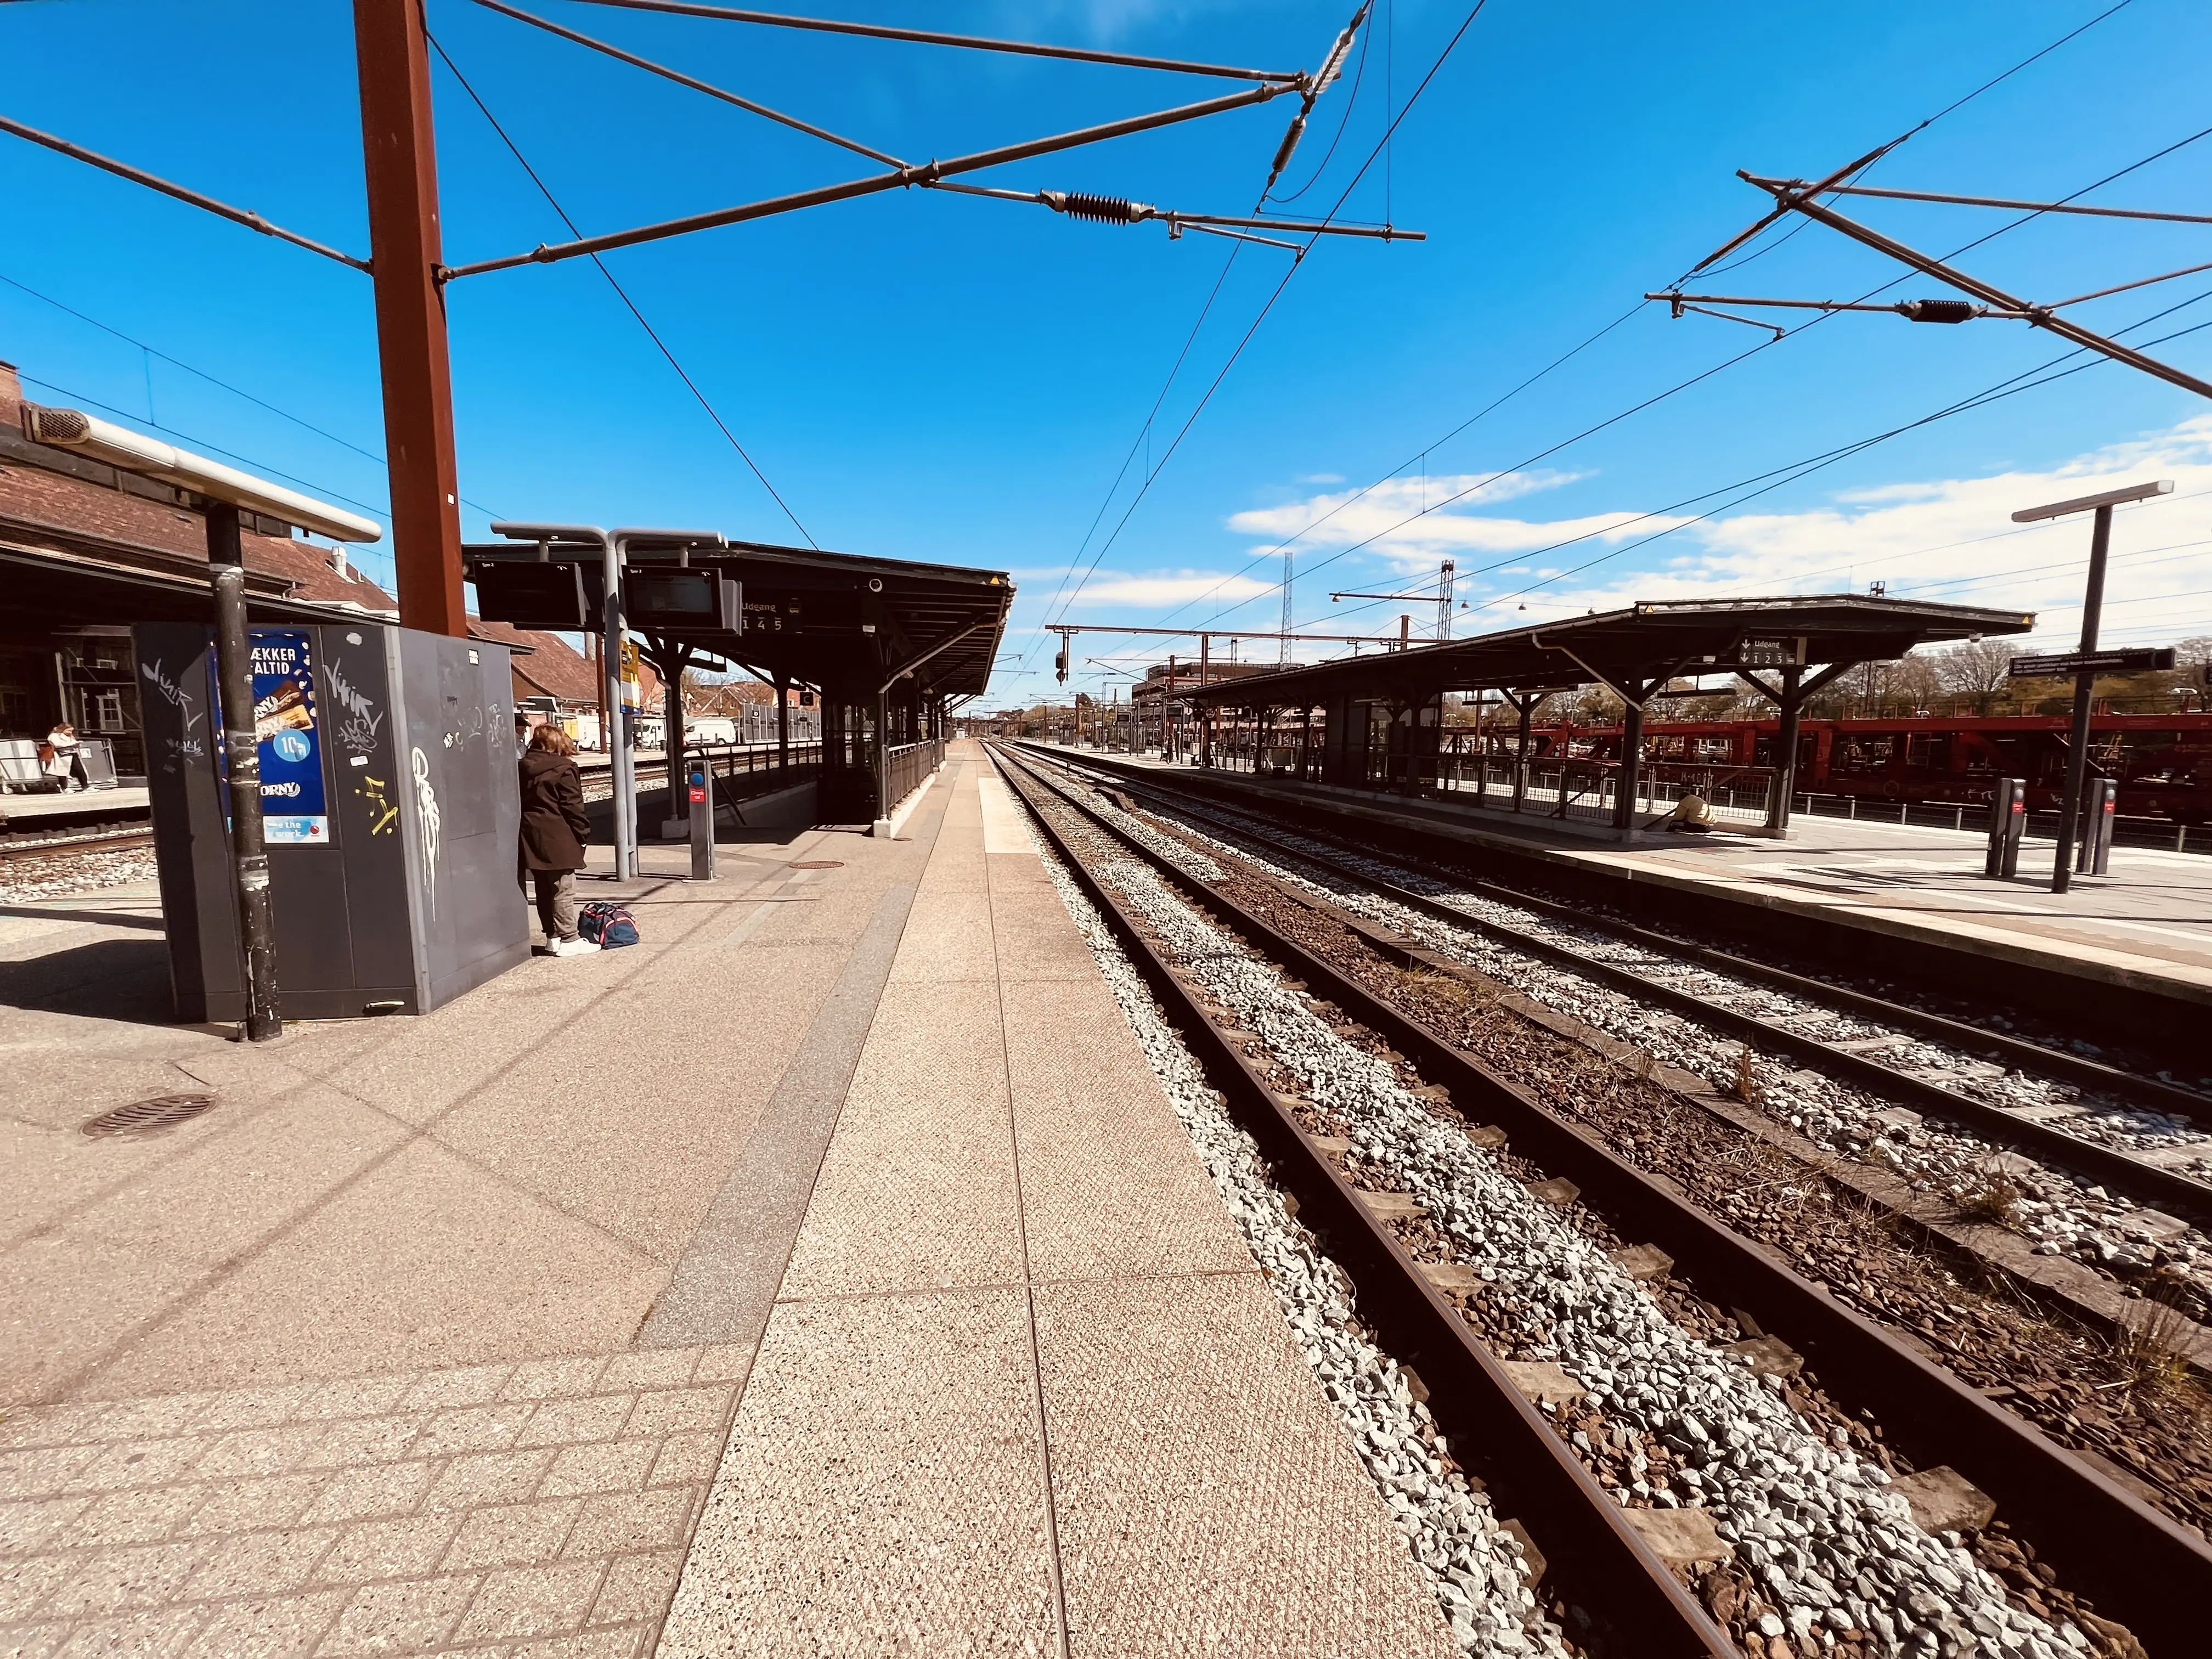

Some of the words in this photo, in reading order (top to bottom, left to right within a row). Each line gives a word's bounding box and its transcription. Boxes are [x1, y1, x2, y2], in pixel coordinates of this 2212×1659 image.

[743, 620, 749, 629] 1
[758, 620, 765, 629] 4
[775, 621, 781, 630] 5
[250, 648, 296, 661] ÆKKER
[1754, 655, 1758, 663] 1
[260, 782, 296, 795] ORNY
